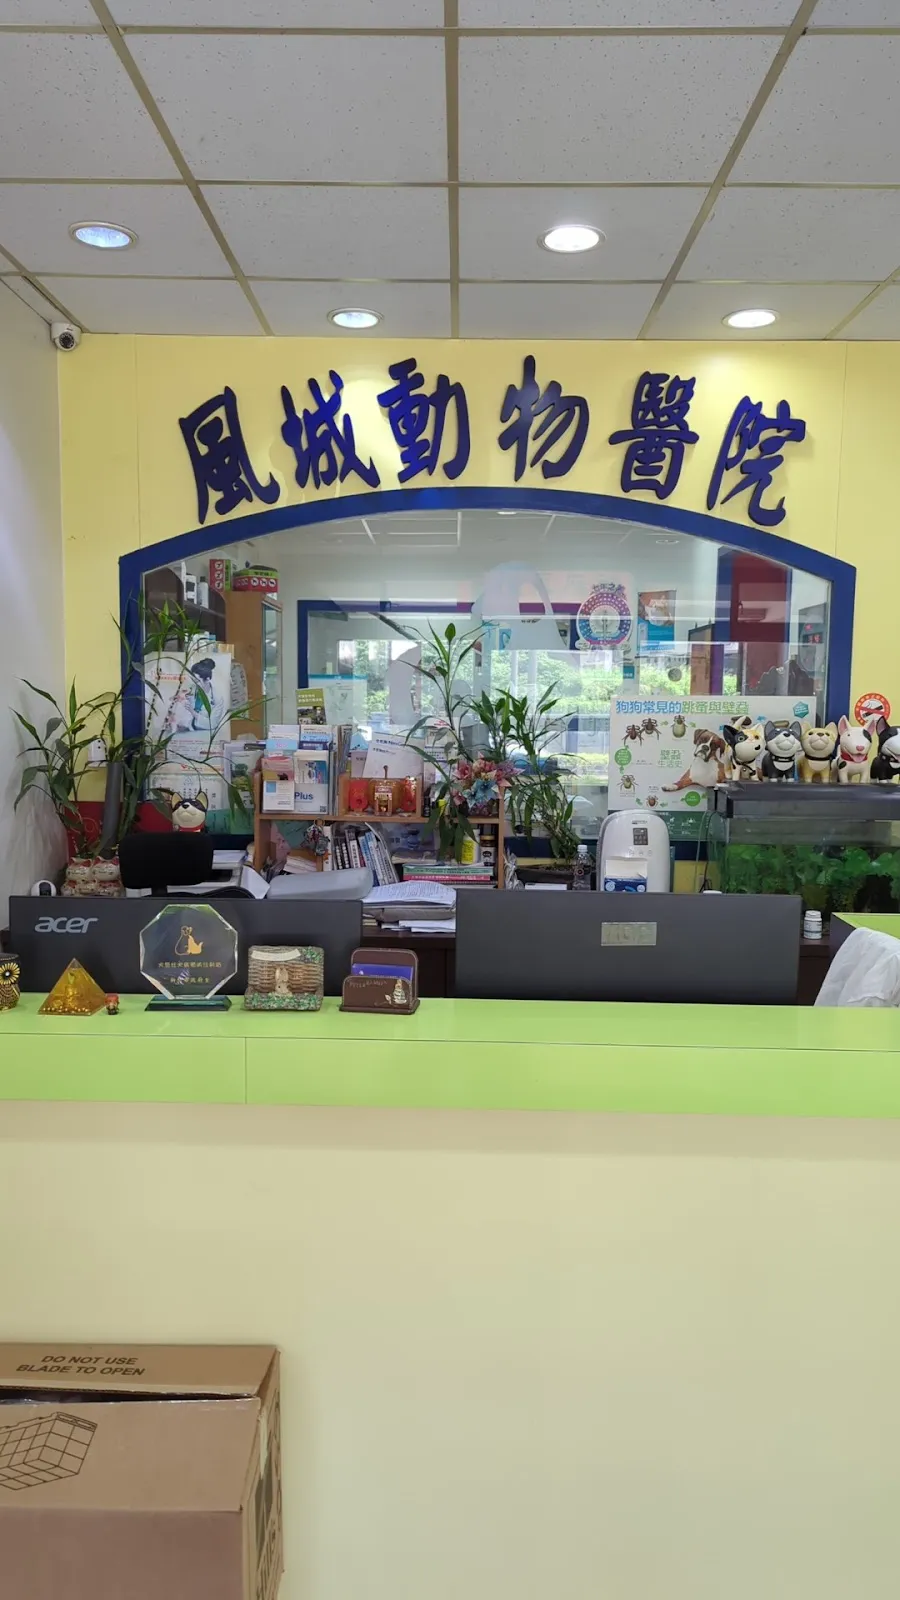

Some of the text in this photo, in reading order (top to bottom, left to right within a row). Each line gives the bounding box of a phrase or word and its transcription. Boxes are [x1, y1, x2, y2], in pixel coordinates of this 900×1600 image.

[178, 355, 806, 526] 風城動物醫院
[294, 791, 314, 800] Plus
[34, 916, 99, 934] acer
[41, 1355, 139, 1365] DO NOT USE
[16, 1364, 146, 1376] BLADE TO OPEN
